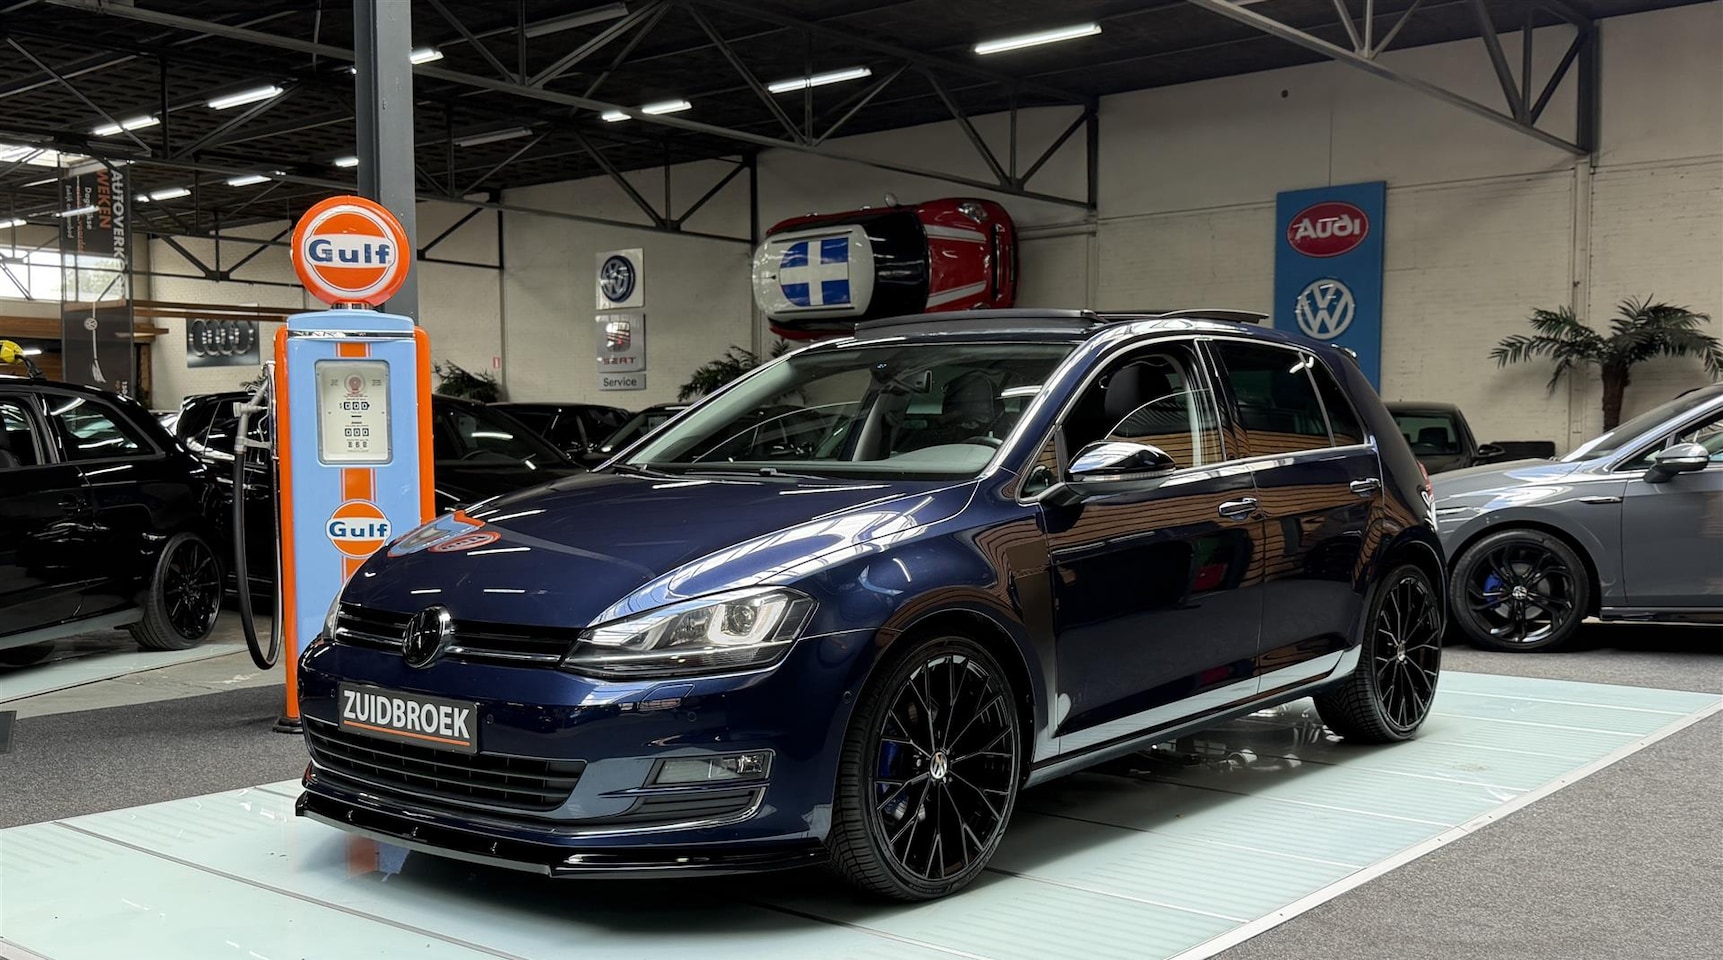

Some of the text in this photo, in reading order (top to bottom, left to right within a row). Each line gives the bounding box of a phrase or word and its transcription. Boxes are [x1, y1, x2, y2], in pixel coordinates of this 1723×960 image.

[97, 168, 111, 228] WEKEN
[308, 239, 390, 264] Gulf
[603, 377, 637, 387] Service
[329, 521, 388, 537] Gulf
[343, 690, 470, 738] ZUIDBROEK
